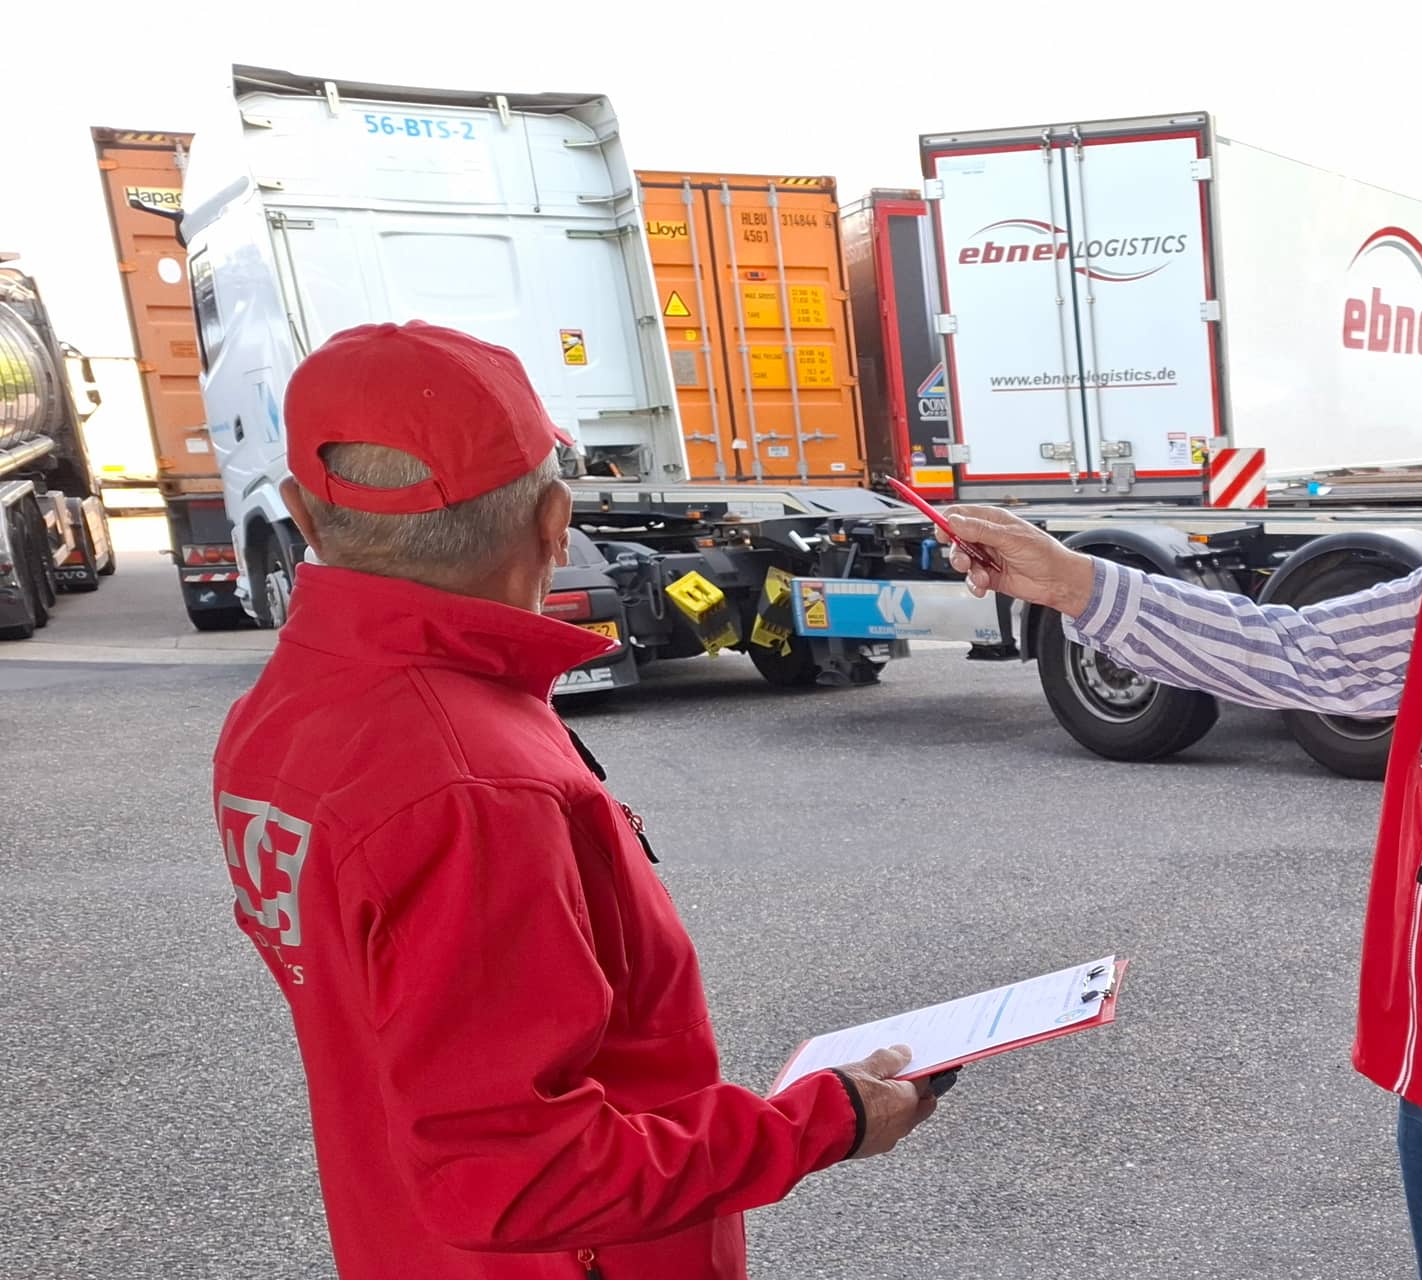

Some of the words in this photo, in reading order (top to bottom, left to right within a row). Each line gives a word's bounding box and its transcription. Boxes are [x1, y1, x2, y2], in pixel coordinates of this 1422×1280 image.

[364, 114, 476, 140] 56-BTS-2
[741, 212, 767, 226] HLBU
[958, 241, 1068, 264] ebner
[1073, 235, 1187, 258] LOGISTICS
[990, 368, 1176, 387] www.ebner-logistics.de
